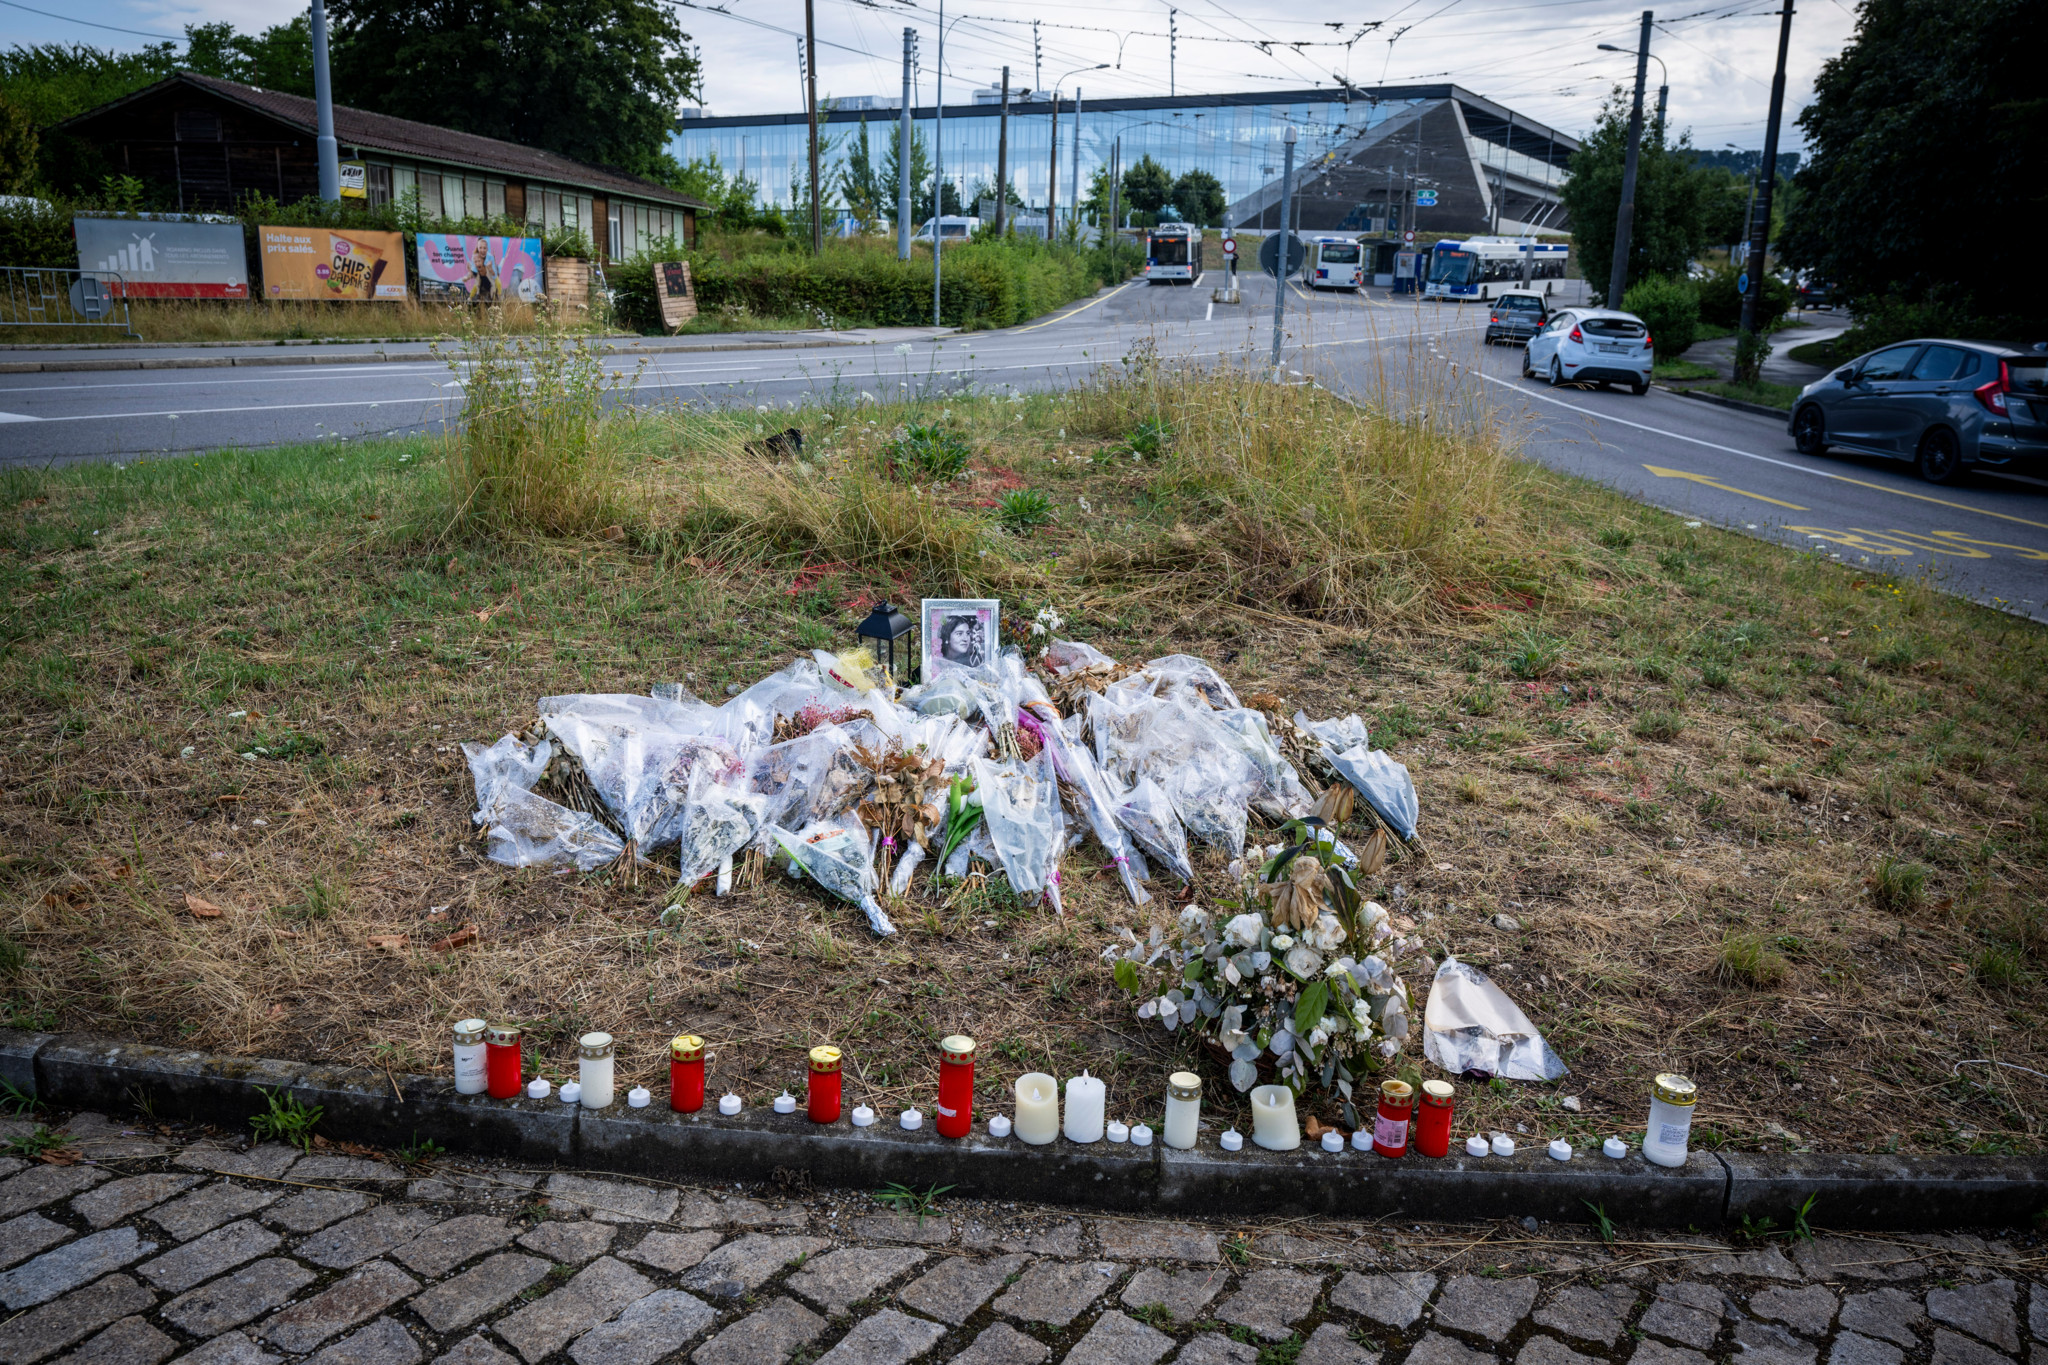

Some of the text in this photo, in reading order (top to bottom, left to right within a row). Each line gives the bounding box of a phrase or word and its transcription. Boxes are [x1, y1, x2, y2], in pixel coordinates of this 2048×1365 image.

[266, 233, 312, 244] Halte aux
[267, 244, 287, 254] prix
[1779, 525, 2048, 560] BUS
